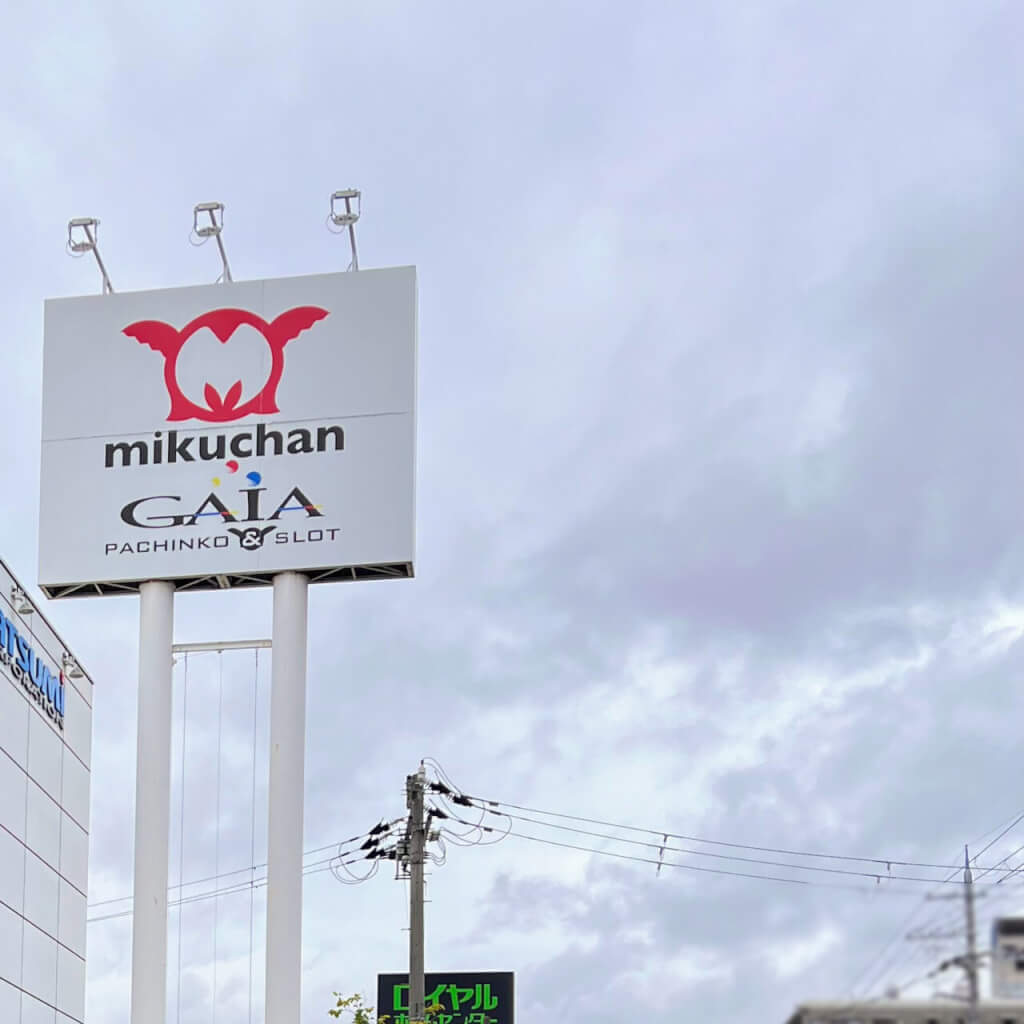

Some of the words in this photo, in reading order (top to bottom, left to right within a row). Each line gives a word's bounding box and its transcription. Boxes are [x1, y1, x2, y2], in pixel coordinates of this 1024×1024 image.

[105, 424, 345, 468] mikuchan
[120, 474, 325, 529] GAIA
[105, 535, 229, 556] PACHINKO
[242, 529, 263, 548] &
[275, 528, 341, 544] SLOT
